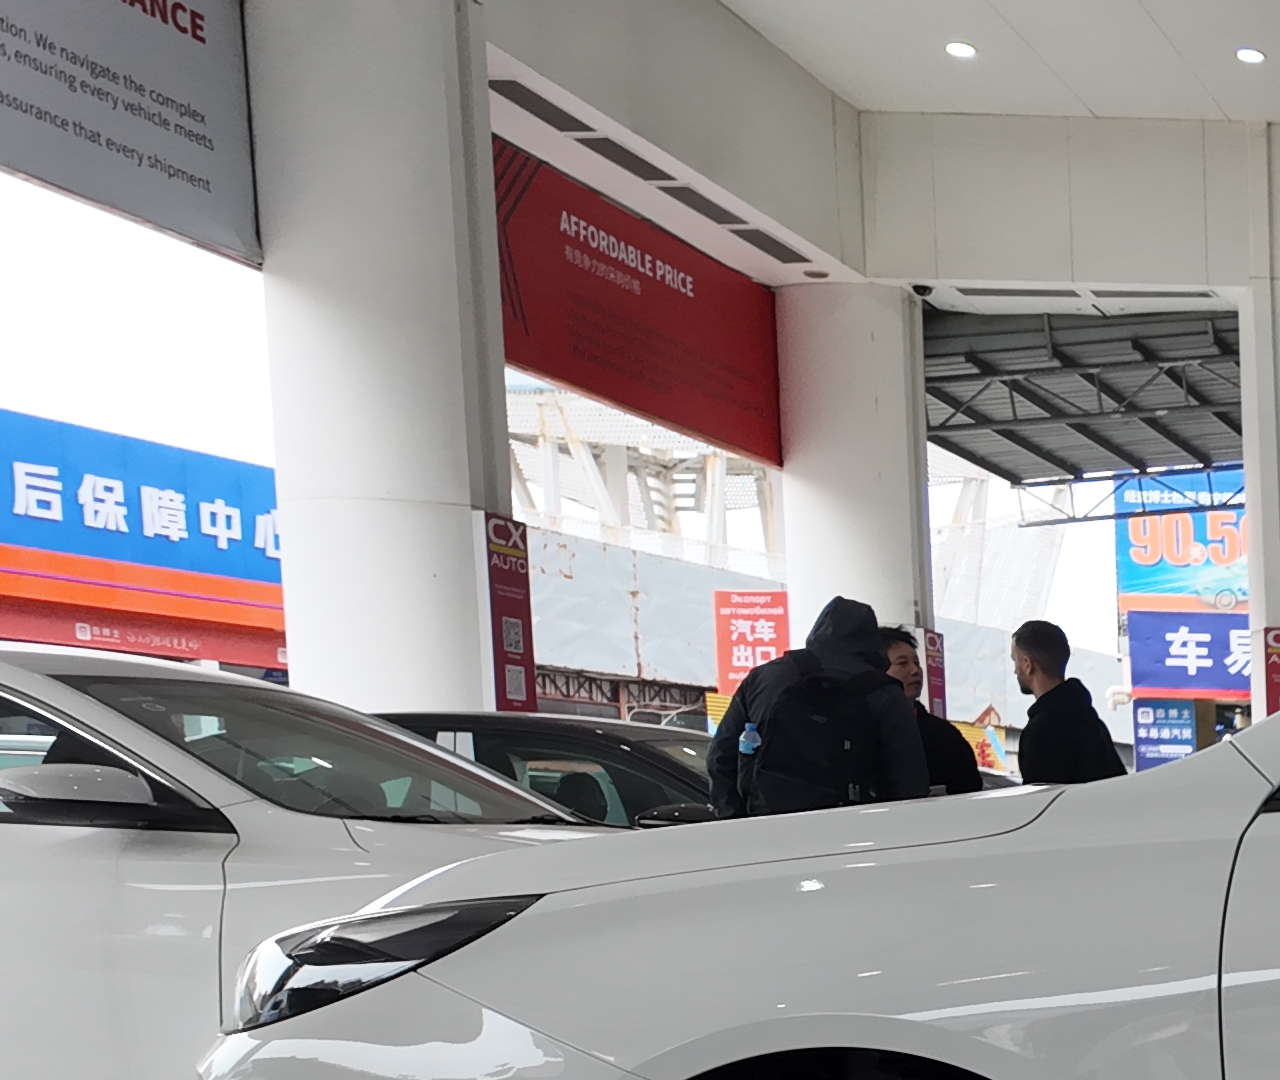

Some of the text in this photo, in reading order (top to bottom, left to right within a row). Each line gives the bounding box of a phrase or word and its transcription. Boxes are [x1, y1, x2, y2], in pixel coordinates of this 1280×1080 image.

[121, 0, 206, 44] ANCE
[34, 30, 56, 55] We
[60, 46, 120, 85] navigate
[123, 74, 146, 97] the
[150, 89, 206, 126] complex
[15, 49, 77, 93] ensuring
[80, 79, 119, 110] every
[122, 99, 170, 131] vehicle
[174, 122, 215, 151] meets
[72, 120, 103, 147] that
[106, 137, 144, 167] every
[147, 154, 212, 193] shipment
[560, 210, 694, 297] AFFORDABLE PRICE
[488, 518, 525, 550] CX
[491, 554, 527, 573] AUTO
[730, 618, 777, 642] 汽车
[926, 632, 943, 651] CX
[732, 644, 776, 667] 出口
